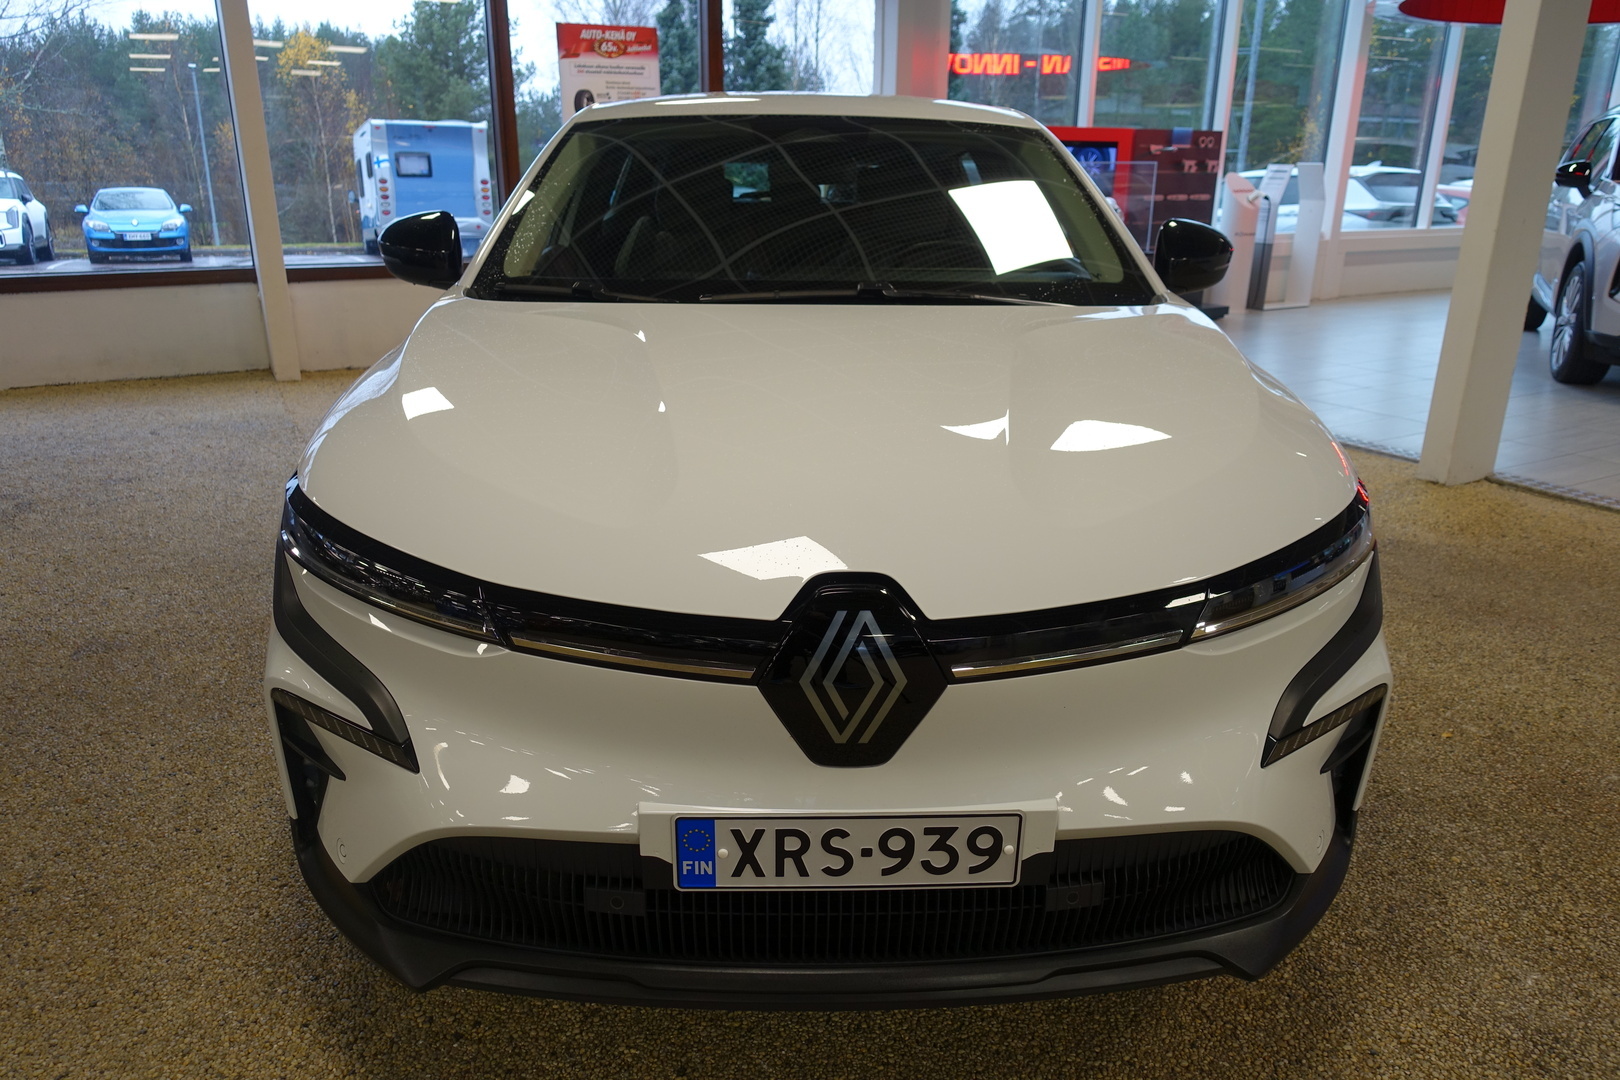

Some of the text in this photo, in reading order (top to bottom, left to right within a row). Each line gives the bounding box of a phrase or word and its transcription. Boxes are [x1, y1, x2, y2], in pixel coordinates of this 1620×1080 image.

[626, 31, 637, 41] OY
[729, 825, 1004, 878] XRS-939
[682, 860, 713, 876] FIN
